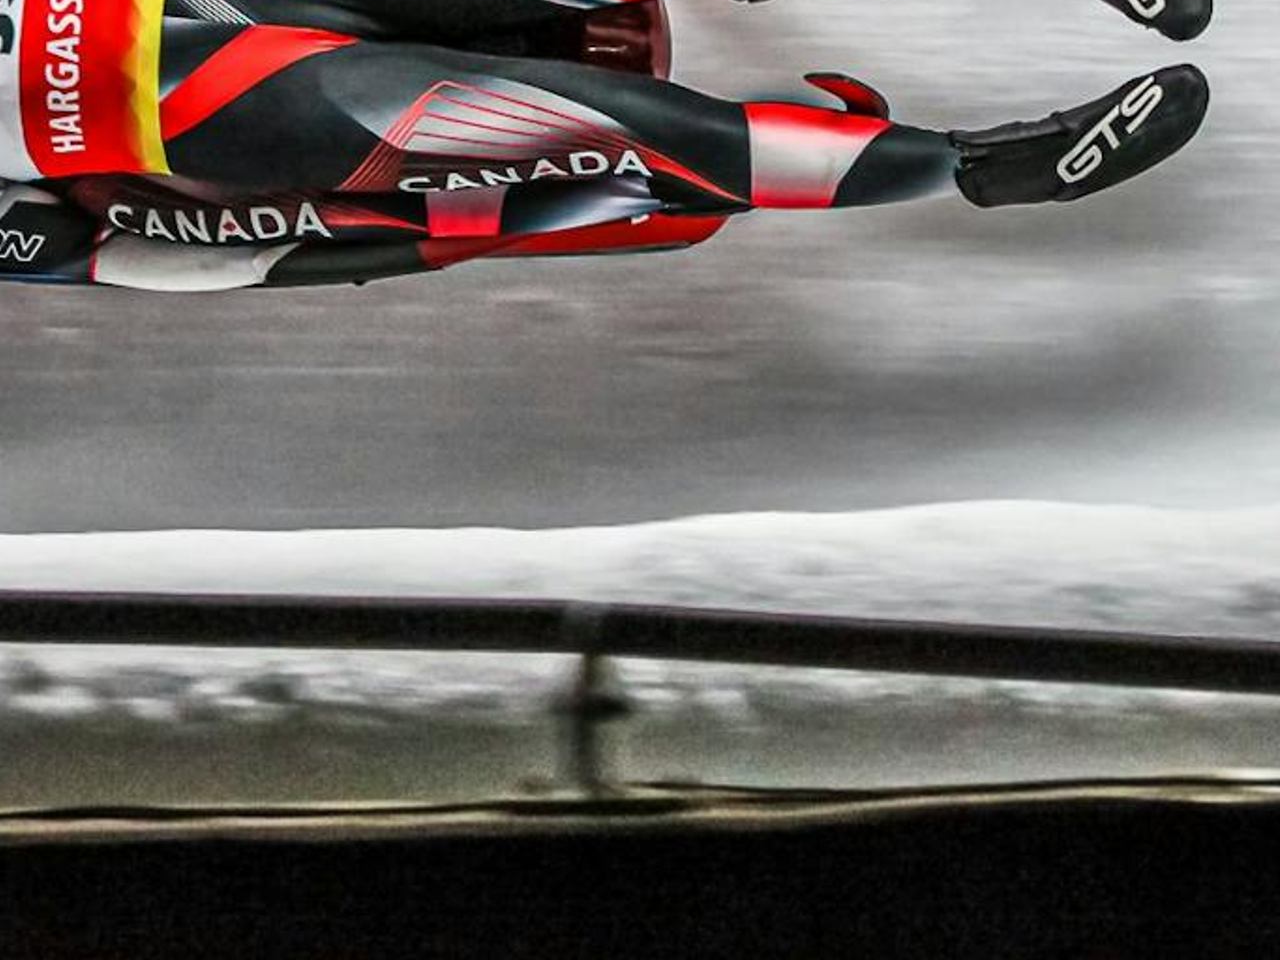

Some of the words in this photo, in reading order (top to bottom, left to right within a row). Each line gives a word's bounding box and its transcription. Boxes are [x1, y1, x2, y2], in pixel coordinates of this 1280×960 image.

[1056, 74, 1164, 184] GTS
[397, 149, 654, 194] CANADA
[106, 201, 333, 245] CANADA
